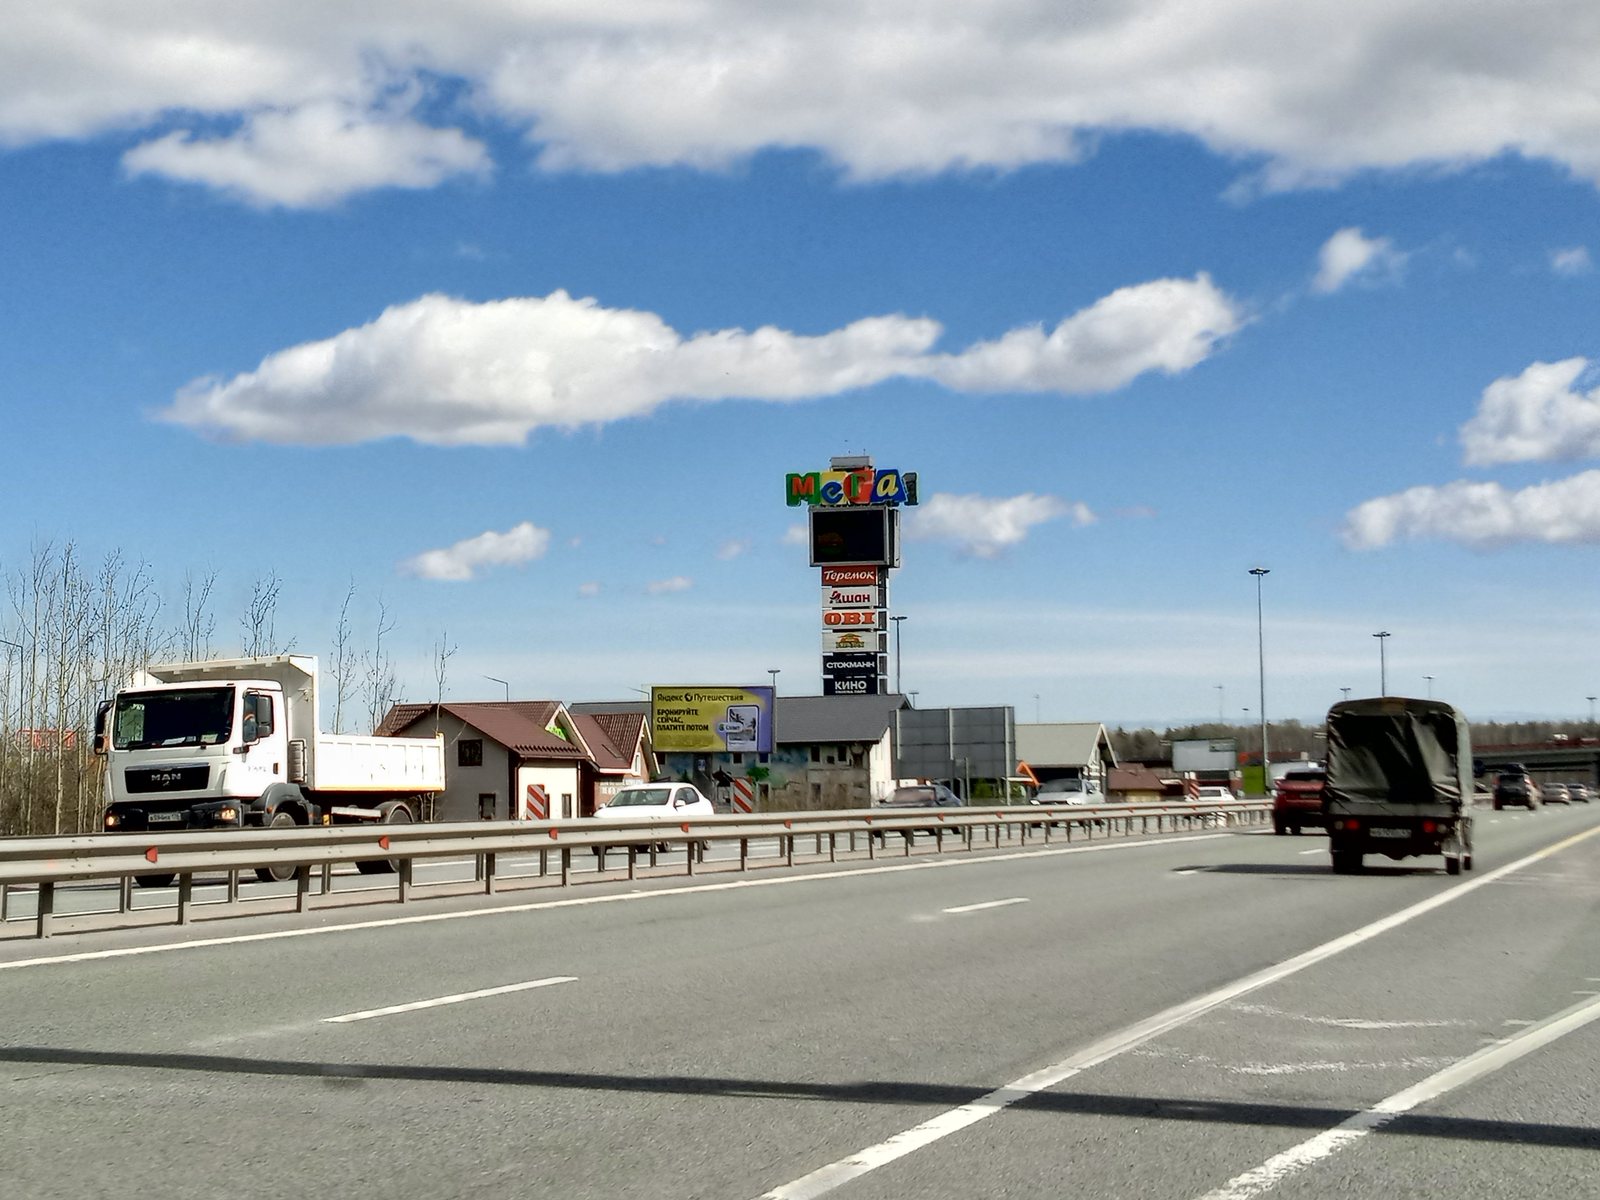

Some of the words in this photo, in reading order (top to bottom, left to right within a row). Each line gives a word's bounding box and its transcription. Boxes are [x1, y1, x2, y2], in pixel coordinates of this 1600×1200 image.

[824, 570, 874, 581] Теремок
[829, 591, 870, 603] Ашан
[824, 612, 875, 625] OBI
[835, 680, 867, 690] КИНО
[657, 693, 683, 702] Яндекс
[694, 694, 744, 702] Путешествия
[151, 773, 182, 781] MAN
